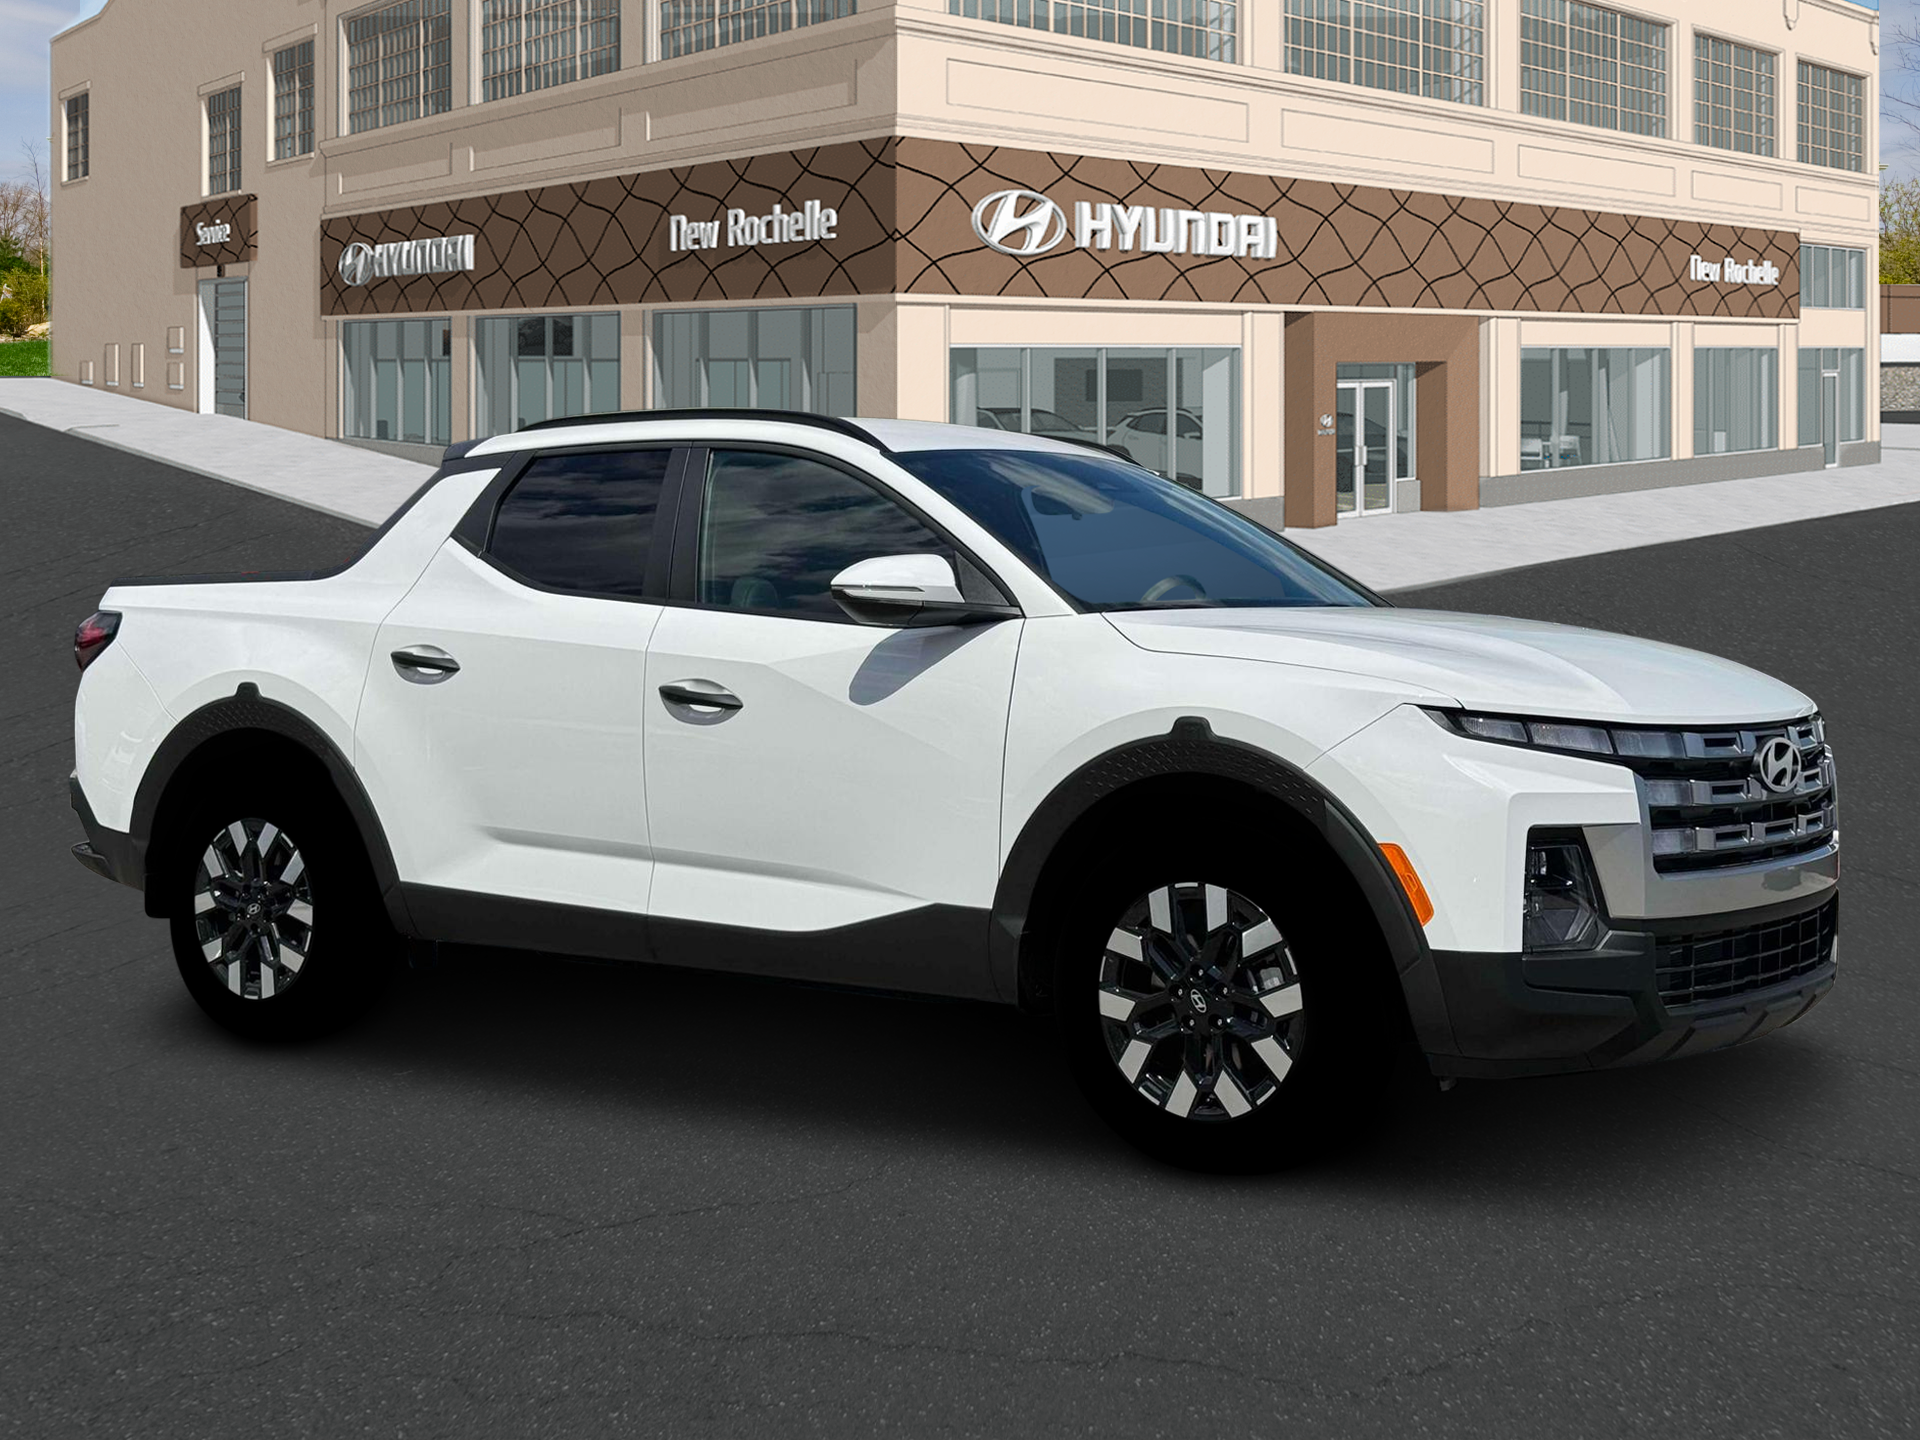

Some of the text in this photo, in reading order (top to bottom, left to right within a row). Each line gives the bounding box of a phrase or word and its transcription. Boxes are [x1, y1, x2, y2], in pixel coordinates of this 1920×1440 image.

[670, 199, 838, 251] New Rochelle
[1074, 201, 1277, 258] HYUNDAI
[374, 234, 475, 277] HYUNDAI
[1690, 254, 1779, 285] New Rochelle
